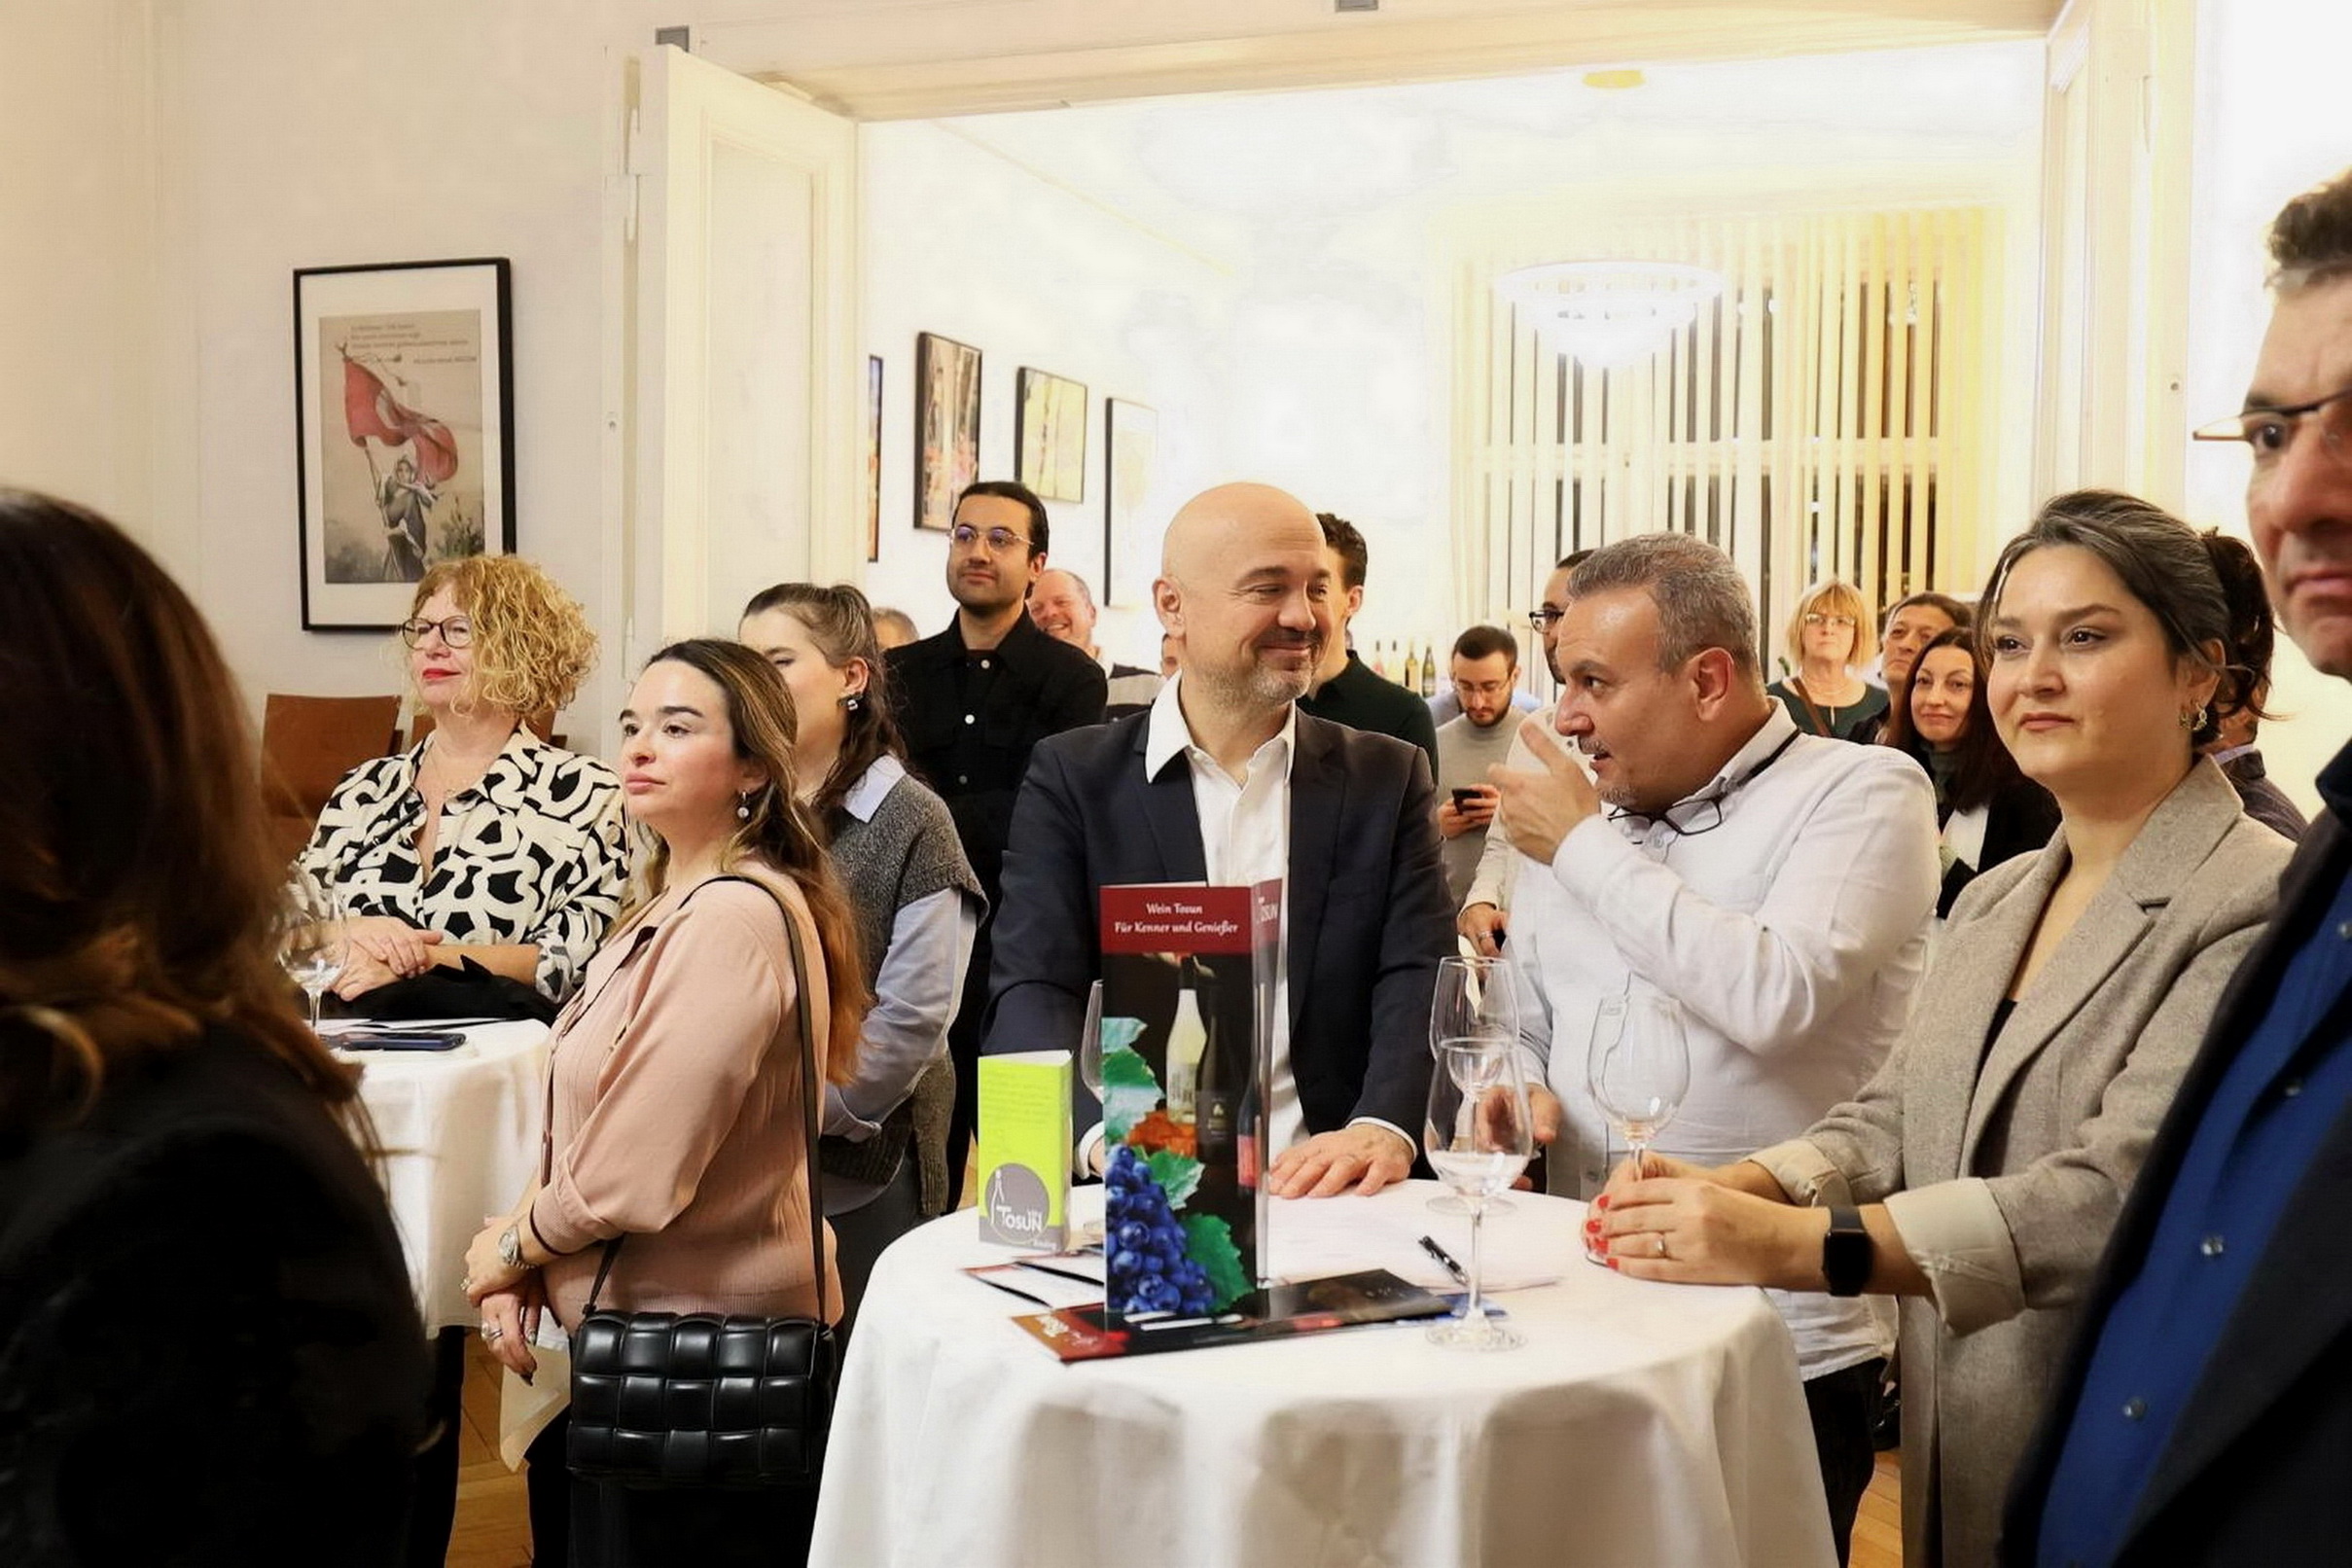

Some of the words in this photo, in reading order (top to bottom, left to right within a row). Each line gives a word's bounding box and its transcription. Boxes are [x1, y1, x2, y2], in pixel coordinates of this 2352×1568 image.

[1147, 903, 1171, 914] Wein
[1115, 921, 1132, 934] Für
[1134, 921, 1169, 934] Kenner
[1172, 920, 1193, 934] und
[1194, 920, 1238, 936] Genießer
